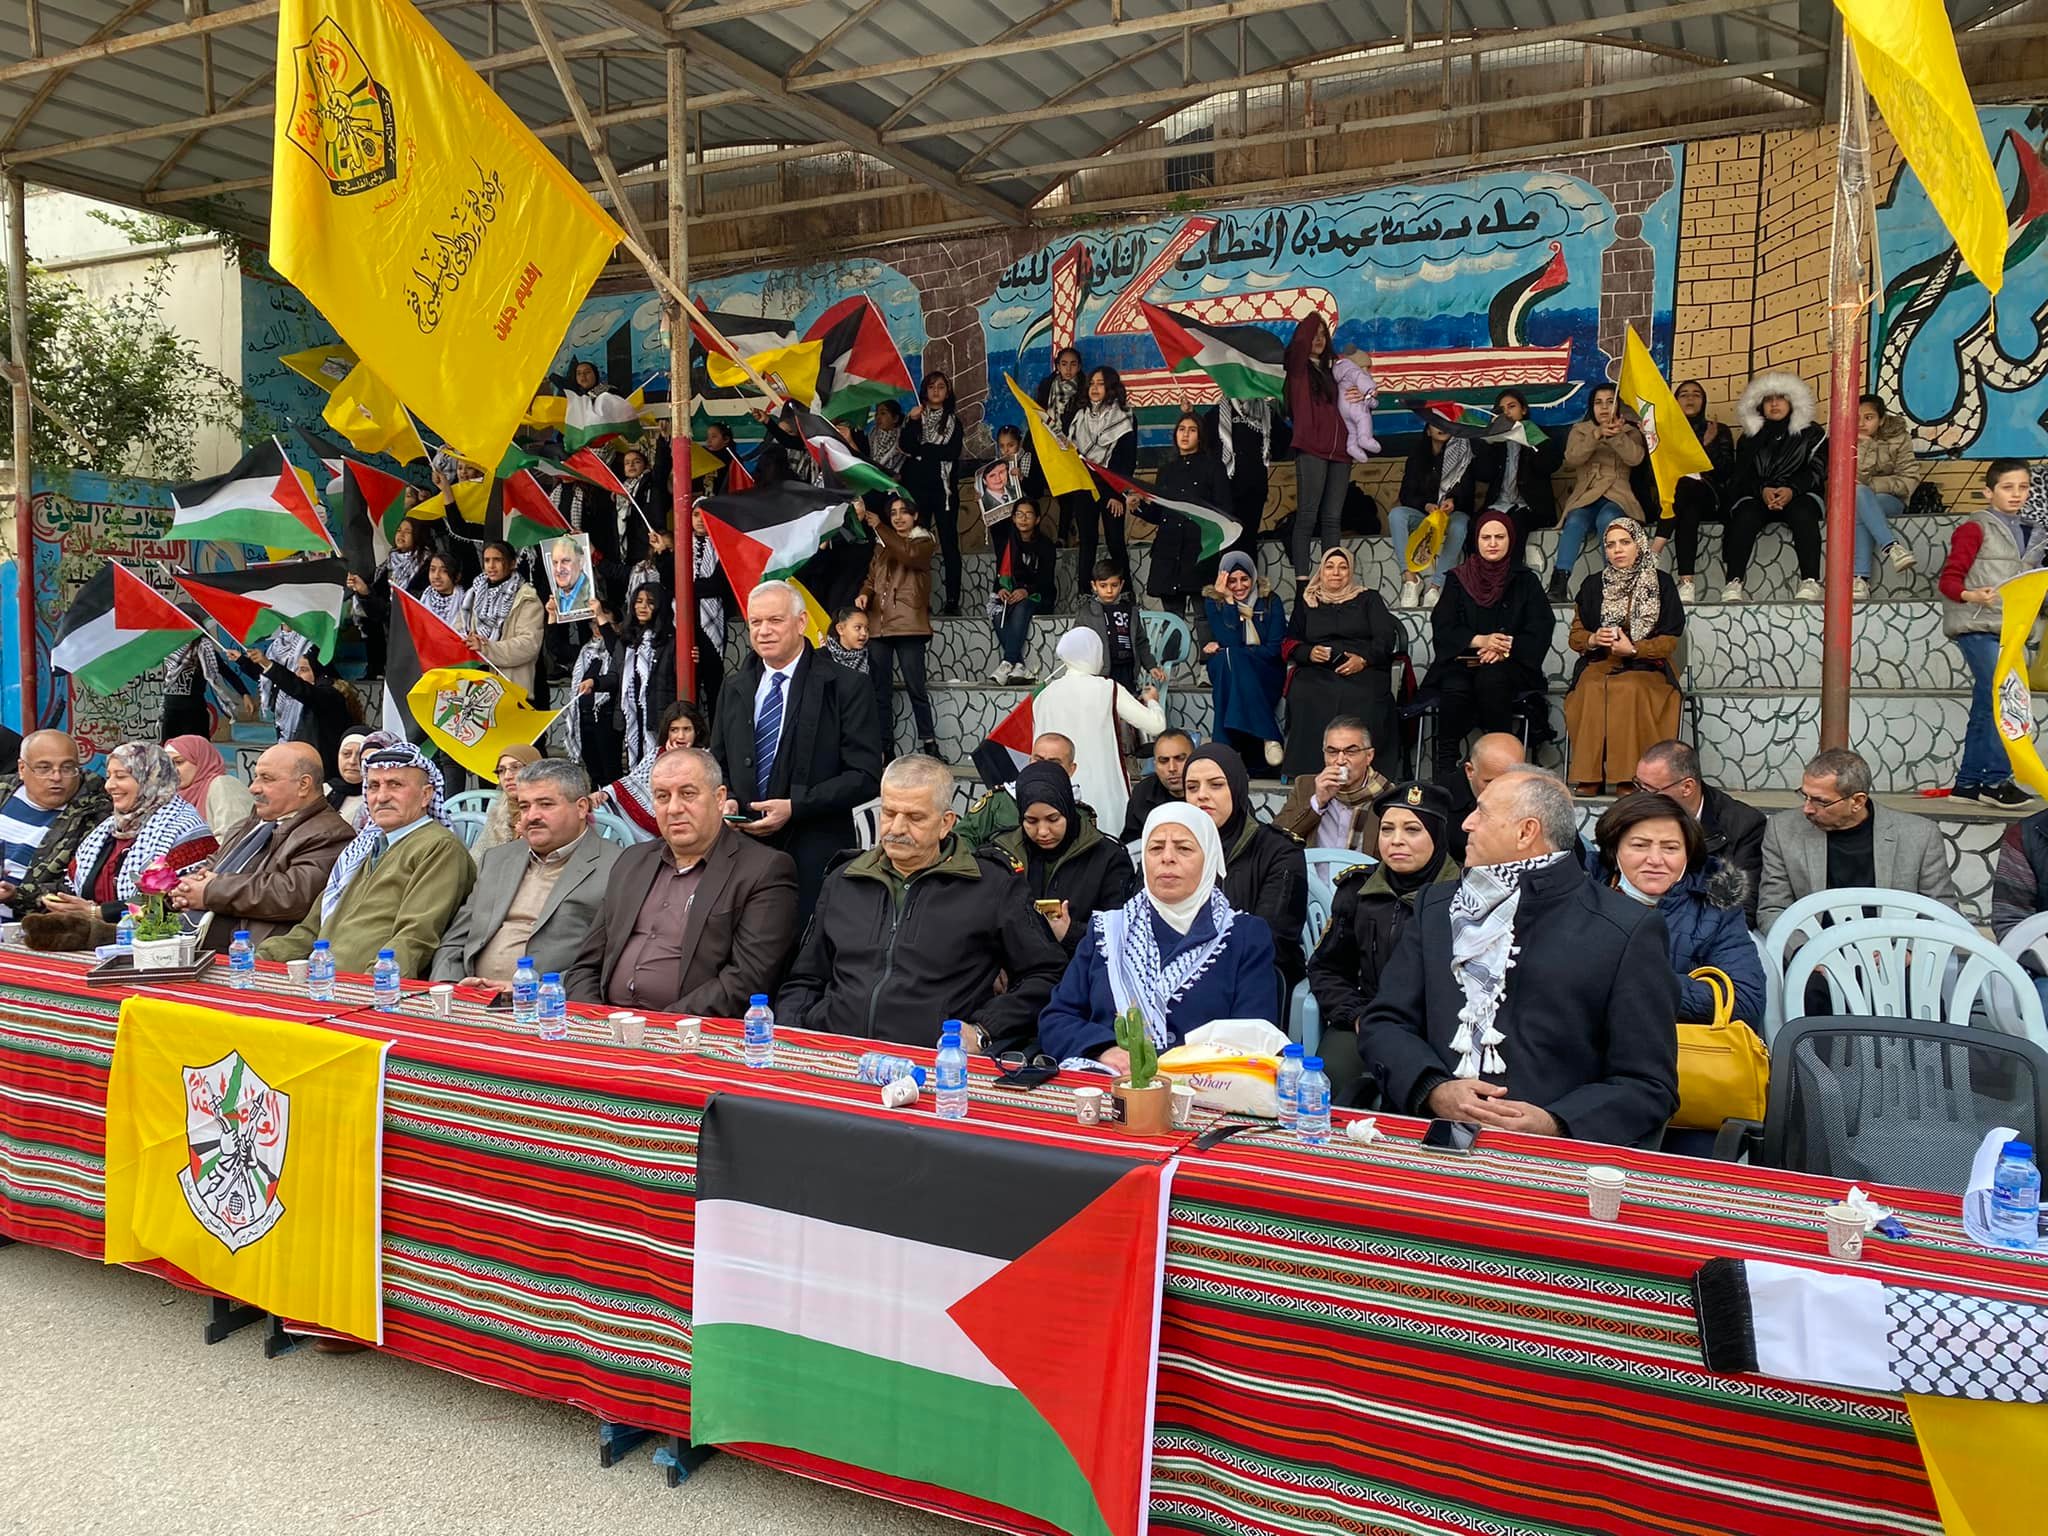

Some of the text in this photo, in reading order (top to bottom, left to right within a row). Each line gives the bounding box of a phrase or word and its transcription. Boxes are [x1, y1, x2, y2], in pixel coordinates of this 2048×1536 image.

[470, 156, 505, 204] حركة
[1174, 208, 1289, 282] الخطاب
[1291, 208, 1322, 258] بن
[493, 306, 517, 341] جنين
[1188, 1071, 1232, 1091] Smart
